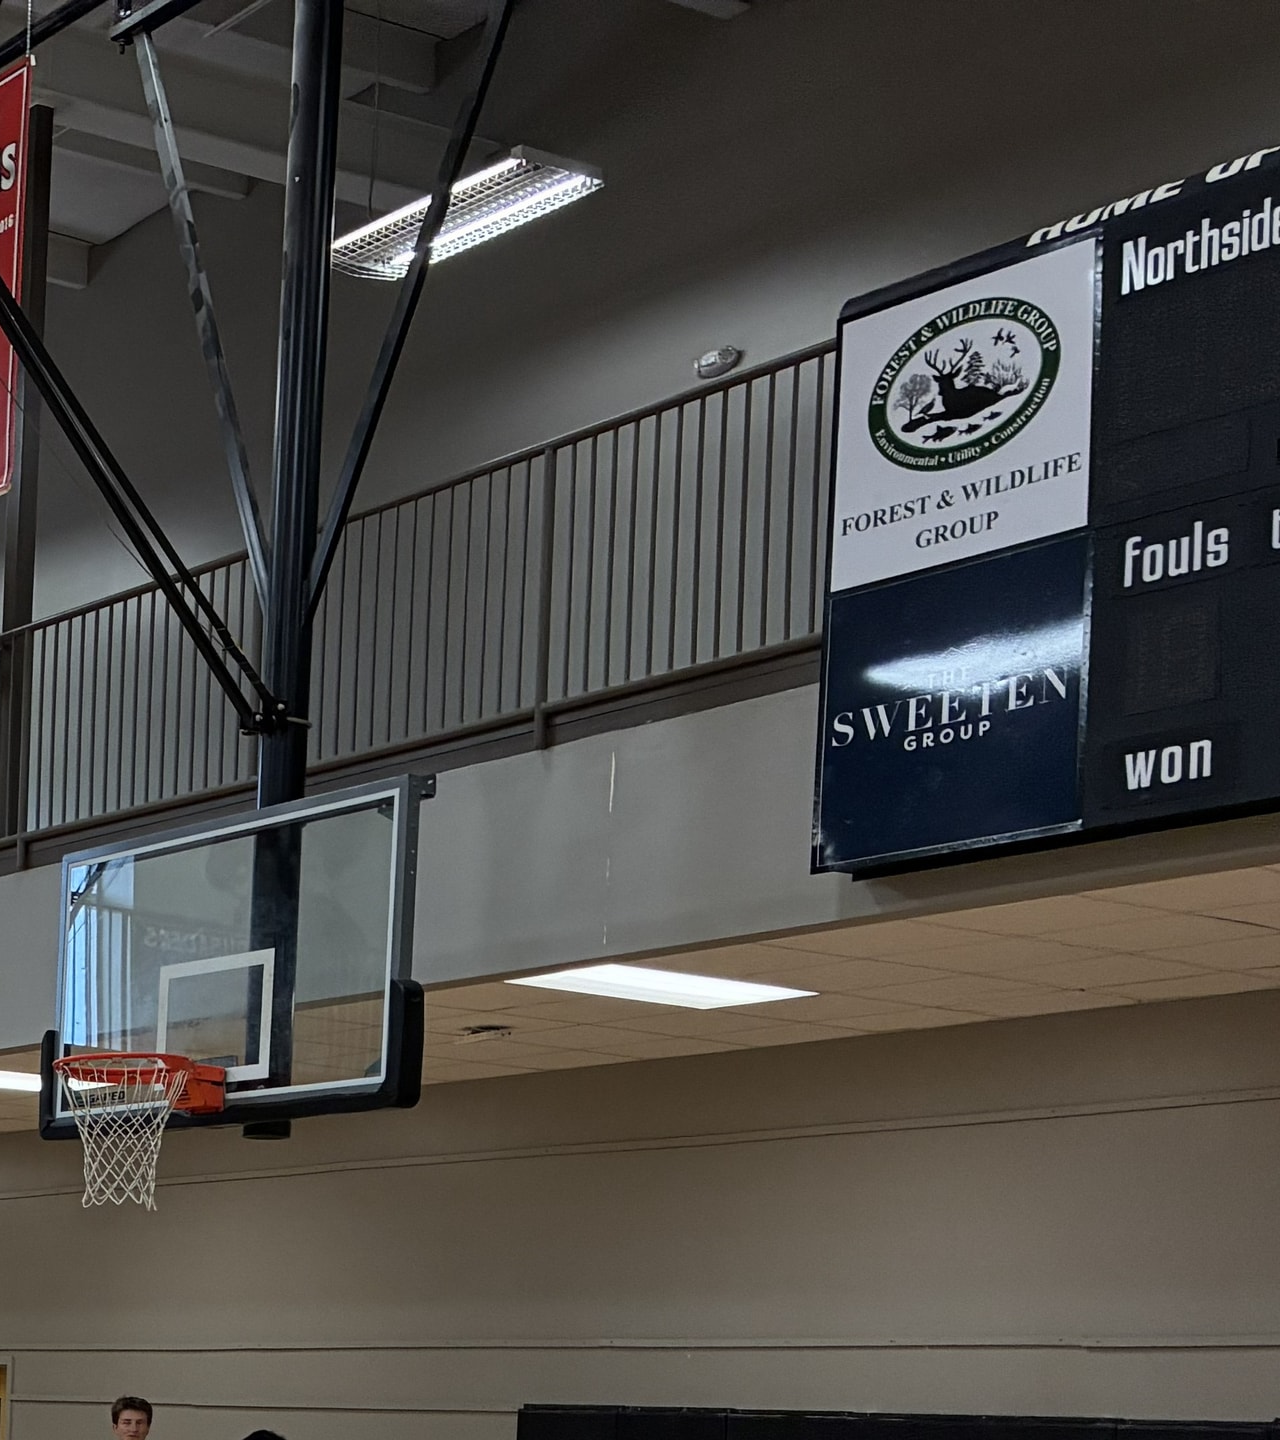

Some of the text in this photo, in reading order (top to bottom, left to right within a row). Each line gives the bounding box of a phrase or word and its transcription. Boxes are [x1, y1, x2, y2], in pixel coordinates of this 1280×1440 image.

[872, 300, 1057, 406] FOREST & WILDLIFE GROUP
[875, 377, 1051, 466] Environmental Utility Construction
[840, 452, 1083, 537] FOREST & WILDLIFE
[915, 510, 1000, 550] GROUP
[903, 720, 991, 751] GROUP
[1124, 738, 1212, 791] won
